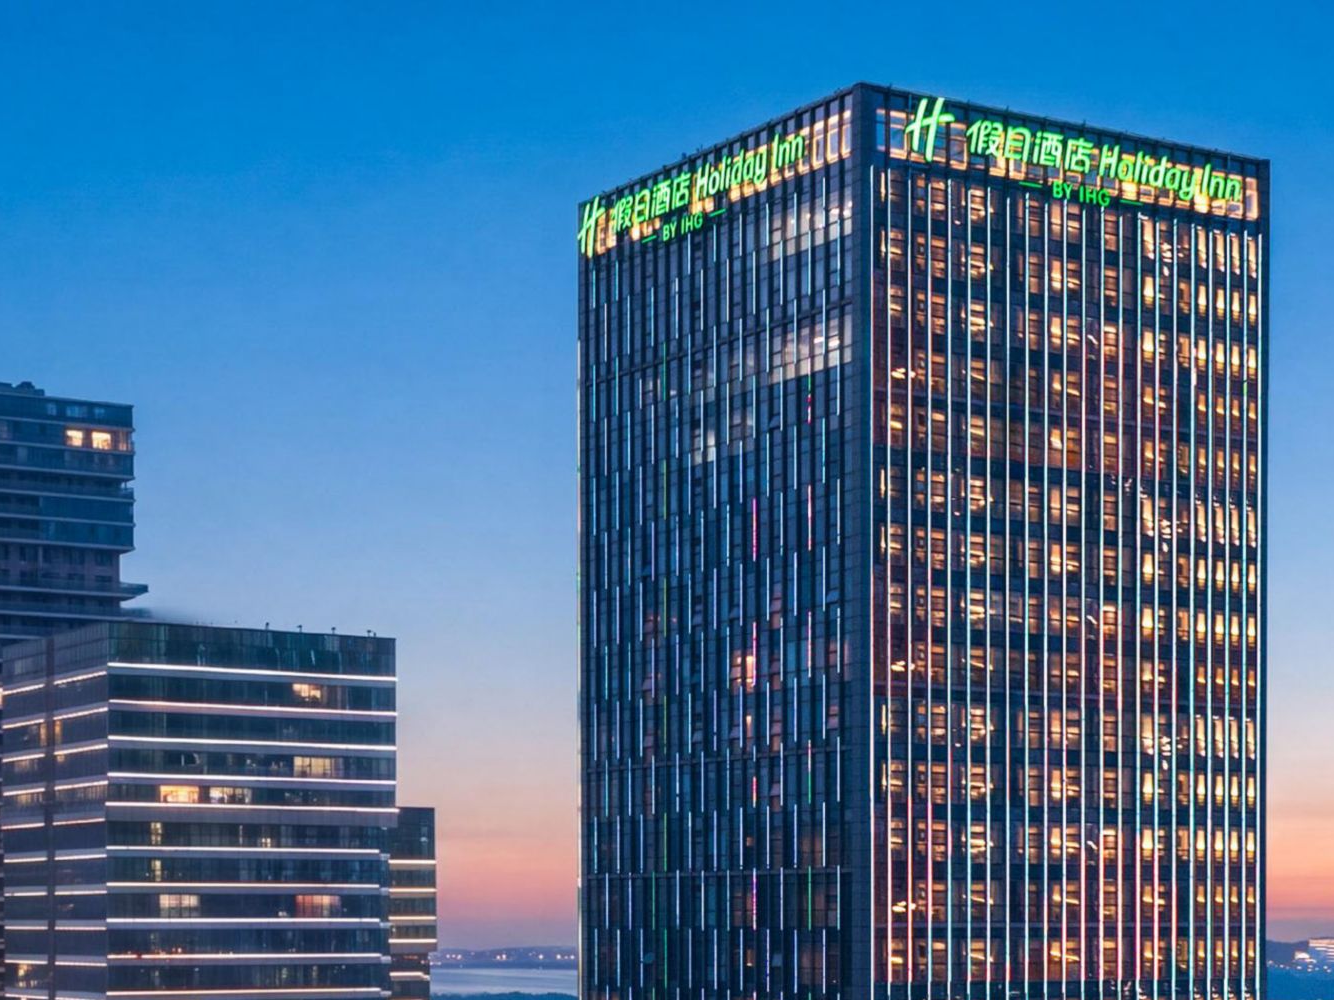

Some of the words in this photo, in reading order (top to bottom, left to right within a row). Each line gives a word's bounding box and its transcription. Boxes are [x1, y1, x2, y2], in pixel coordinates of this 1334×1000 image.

[611, 172, 691, 234] 假日酒店
[696, 148, 767, 200] Holiday
[771, 133, 804, 169] Inn
[966, 119, 1094, 173] 假日酒店
[1099, 144, 1197, 200] Holiday
[1201, 163, 1242, 201] Inn
[1052, 180, 1073, 200] BY
[1079, 185, 1110, 206] IHG
[663, 221, 677, 241] BY
[681, 212, 703, 235] IHG
